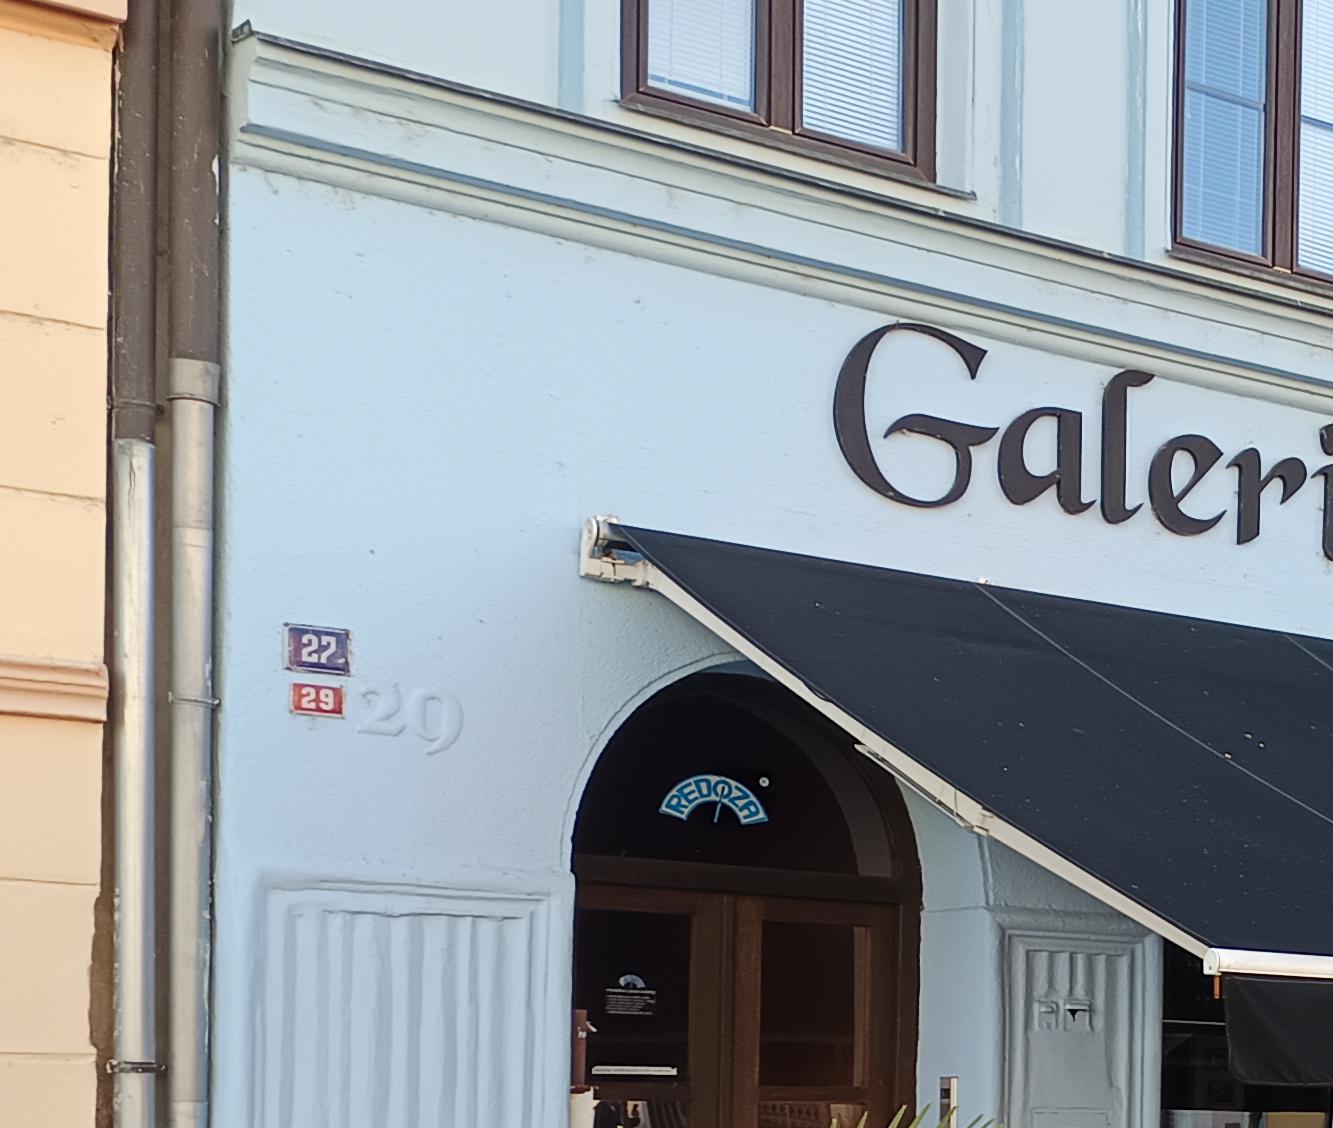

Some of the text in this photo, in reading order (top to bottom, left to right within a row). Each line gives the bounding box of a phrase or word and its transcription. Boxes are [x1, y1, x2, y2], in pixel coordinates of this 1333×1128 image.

[301, 634, 337, 664] 27
[301, 687, 334, 710] 29
[357, 682, 464, 756] 29
[665, 778, 761, 820] REDOZA
